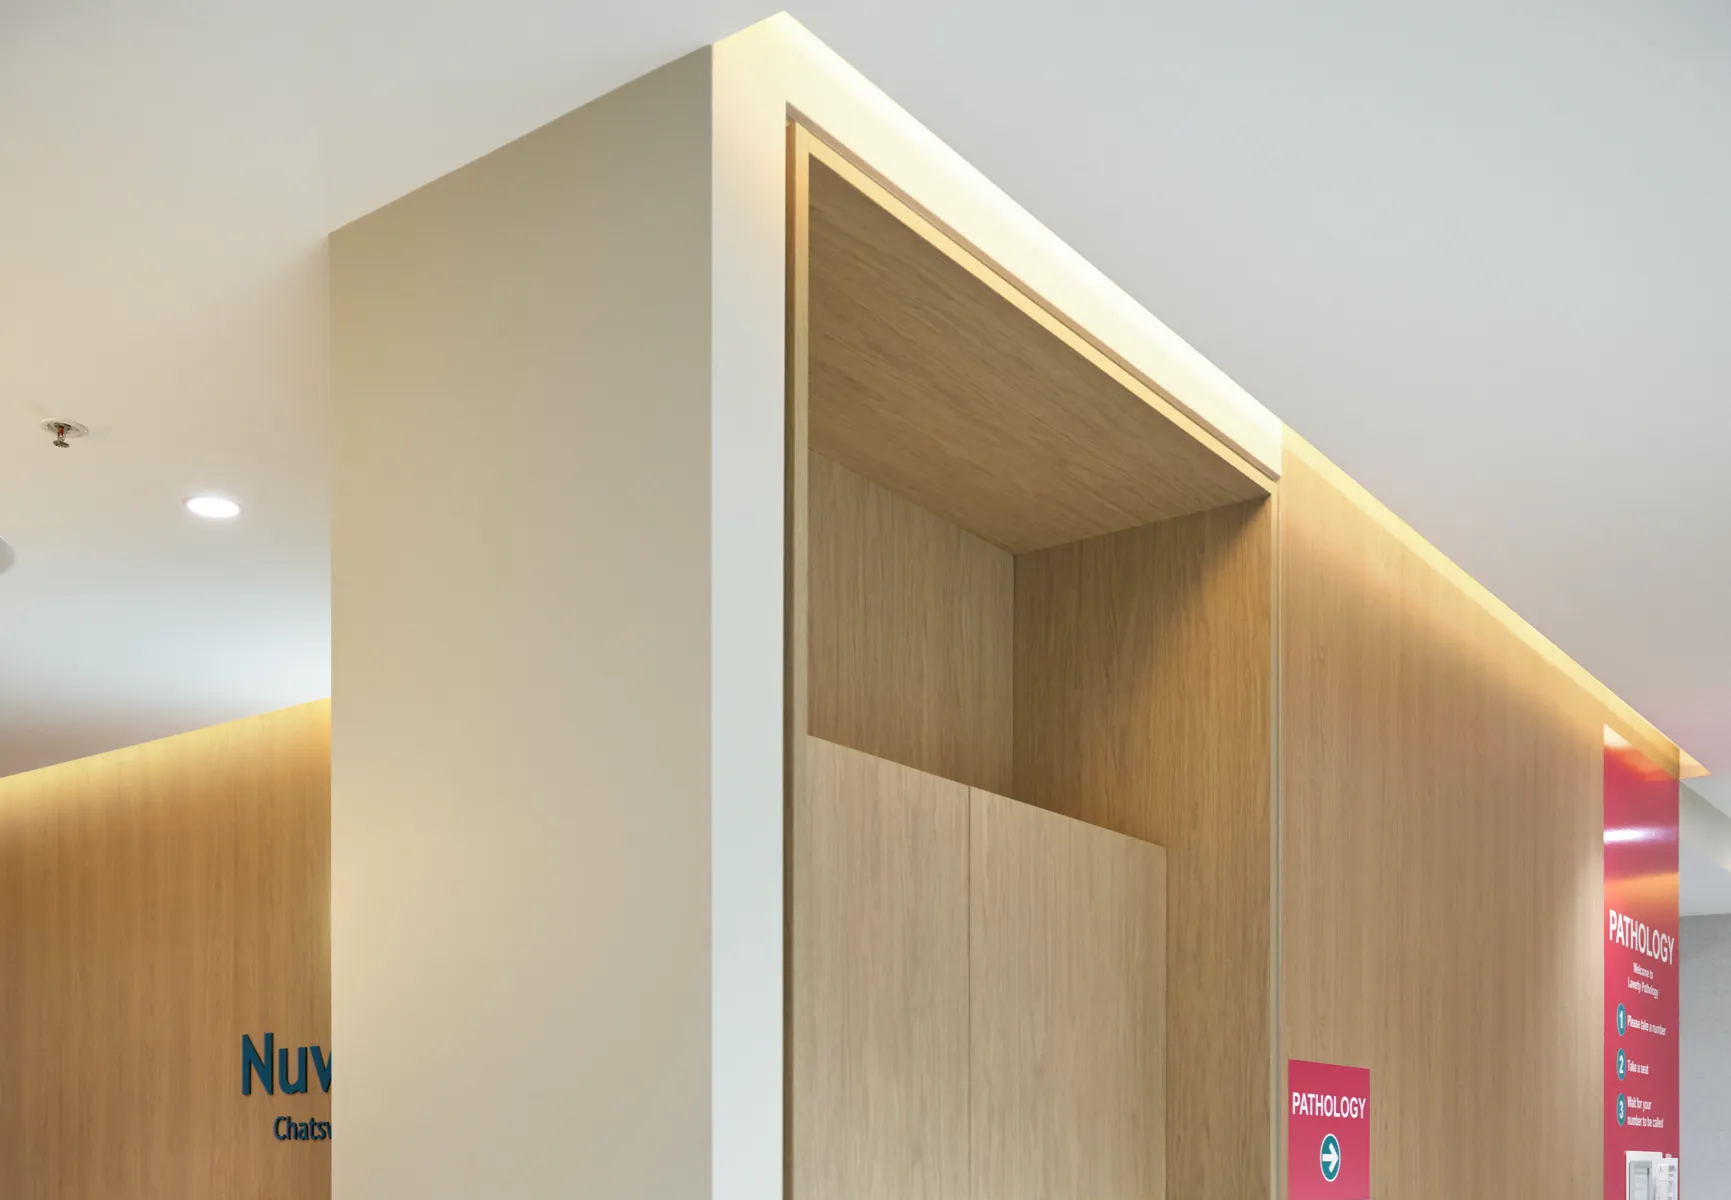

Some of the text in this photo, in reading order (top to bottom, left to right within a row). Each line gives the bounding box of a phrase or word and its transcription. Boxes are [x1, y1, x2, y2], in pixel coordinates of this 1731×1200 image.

[1609, 908, 1675, 965] PATHOLOGY
[1632, 962, 1650, 978] Welcome
[1627, 976, 1659, 999] Laverty Pathology
[1627, 1014, 1641, 1029] Please
[1640, 1019, 1649, 1031] take
[1627, 1059, 1637, 1073] Take
[1640, 1064, 1649, 1075] seat
[1292, 1091, 1366, 1119] PATHOLOGY
[1626, 1095, 1636, 1108] Wait
[1642, 1101, 1652, 1112] your
[274, 1116, 331, 1141] Chats
[1627, 1115, 1642, 1127] number
[1647, 1116, 1652, 1127] be
